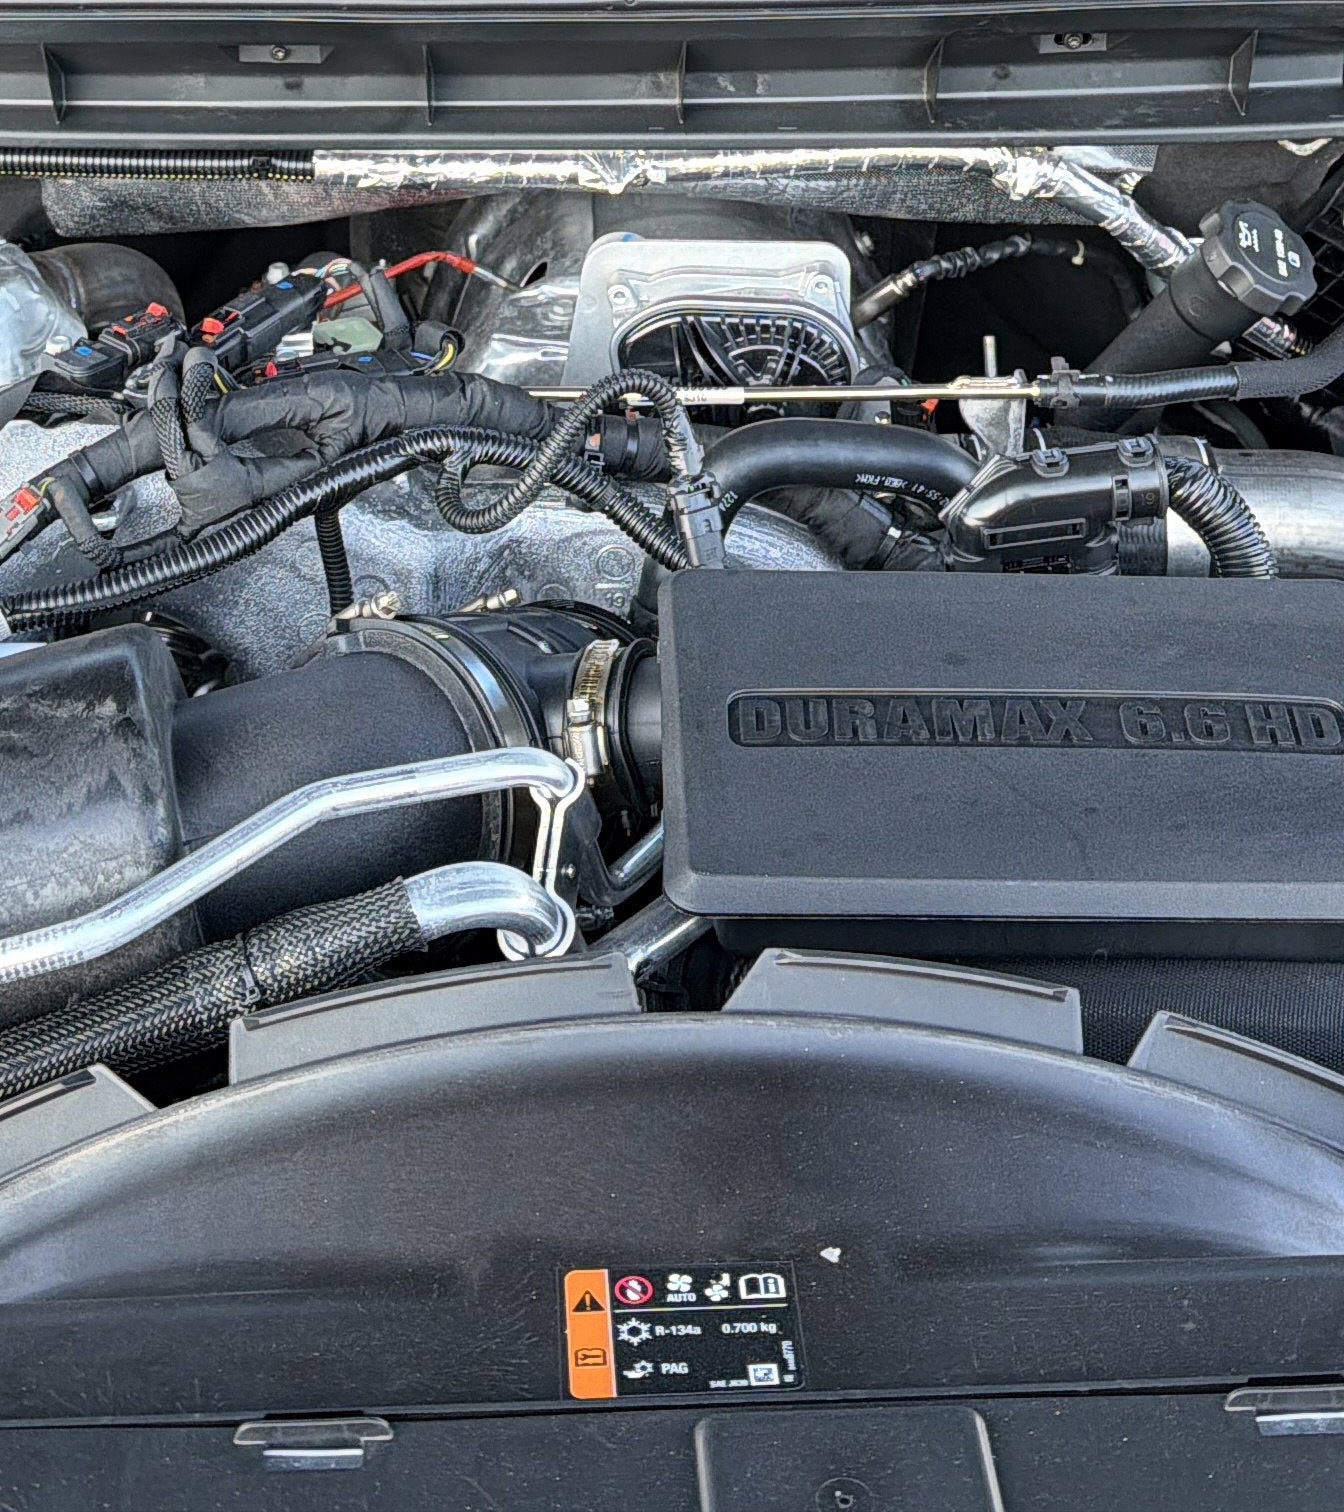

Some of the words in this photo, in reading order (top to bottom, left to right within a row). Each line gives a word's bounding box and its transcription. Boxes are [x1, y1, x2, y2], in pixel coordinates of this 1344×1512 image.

[739, 698, 1093, 743] DURAMAX
[1119, 702, 1231, 745] 6.6
[1245, 702, 1343, 747] HD
[666, 1292, 697, 1303] AUTO
[655, 1324, 702, 1337] R-134a
[721, 1322, 757, 1334] 0.700
[760, 1321, 777, 1335] kg
[661, 1362, 689, 1375] PAG
